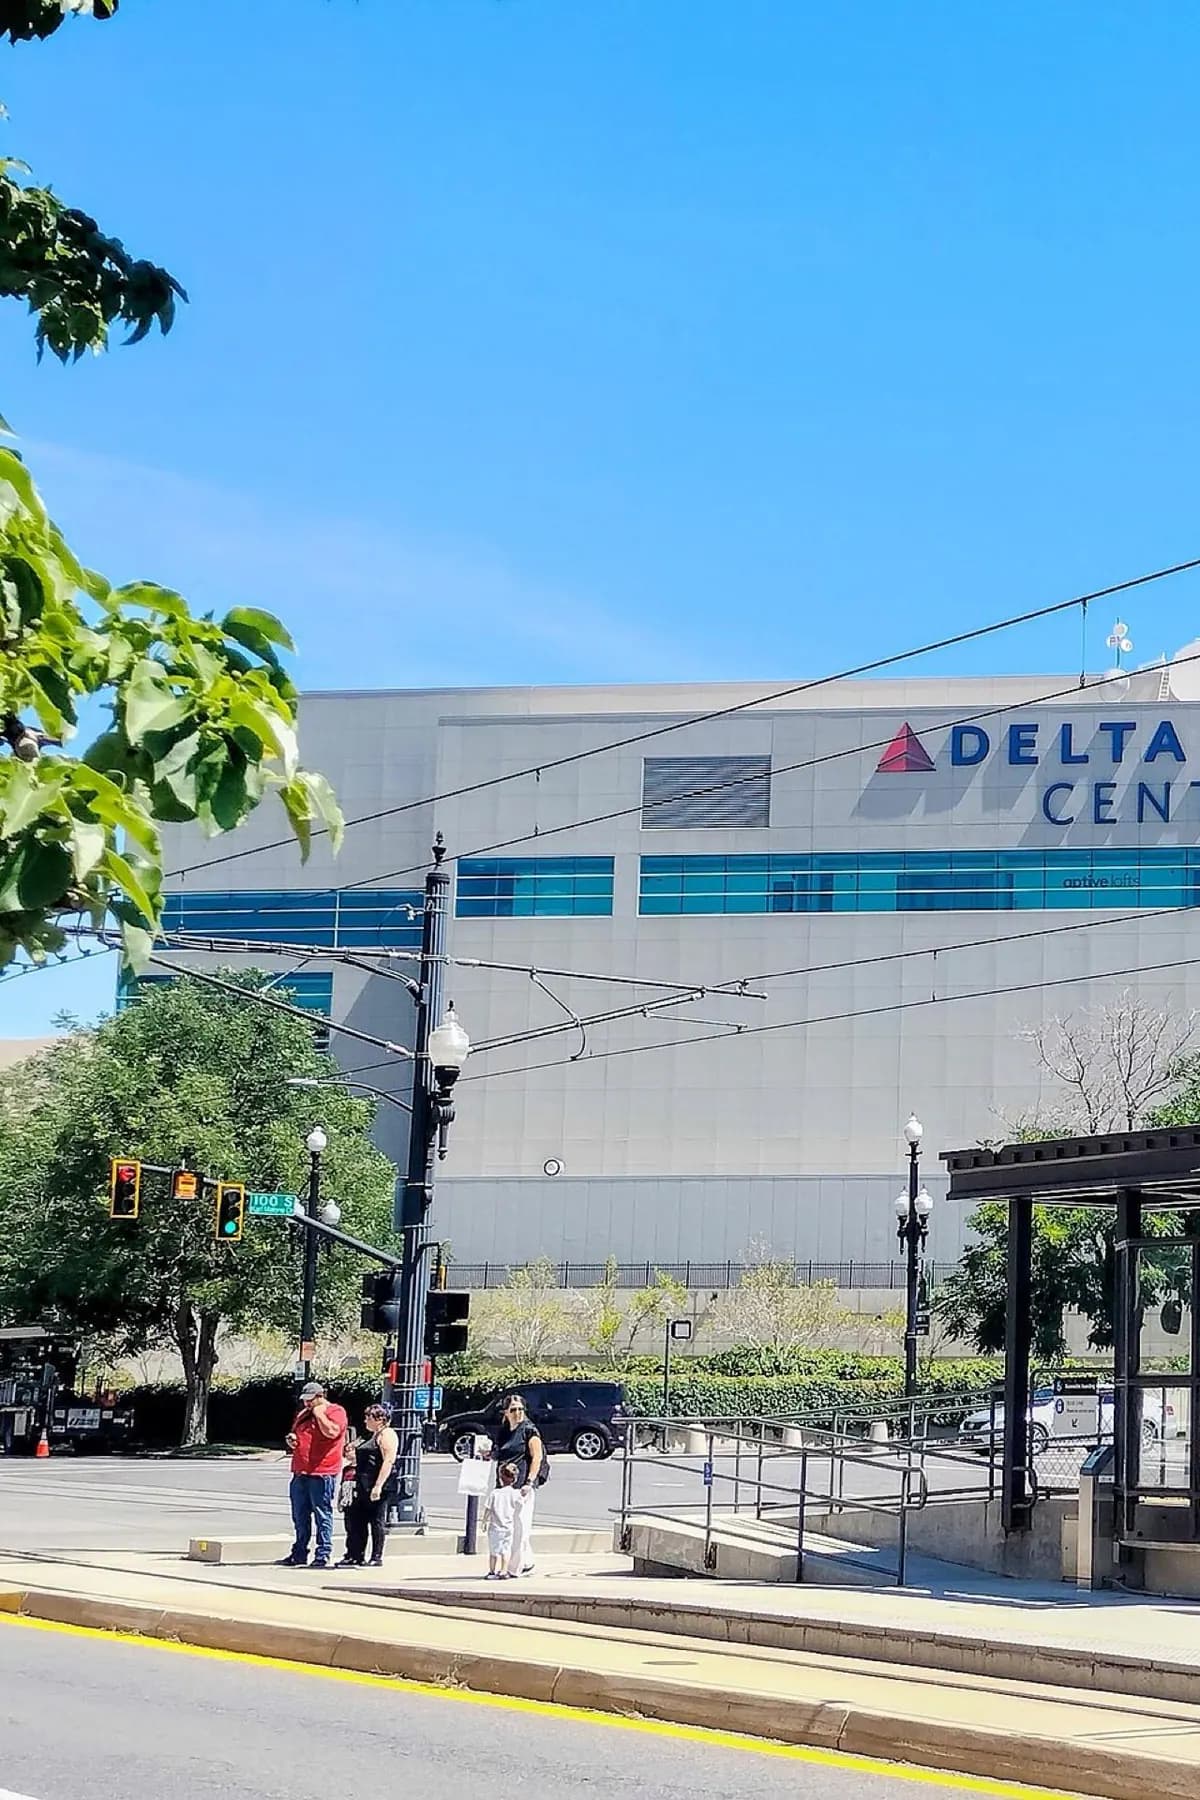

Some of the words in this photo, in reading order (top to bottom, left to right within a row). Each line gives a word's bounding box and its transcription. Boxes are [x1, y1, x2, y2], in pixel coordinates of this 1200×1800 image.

[950, 720, 1187, 766] DELTA
[254, 1195, 278, 1207] 100
[284, 1197, 293, 1207] S
